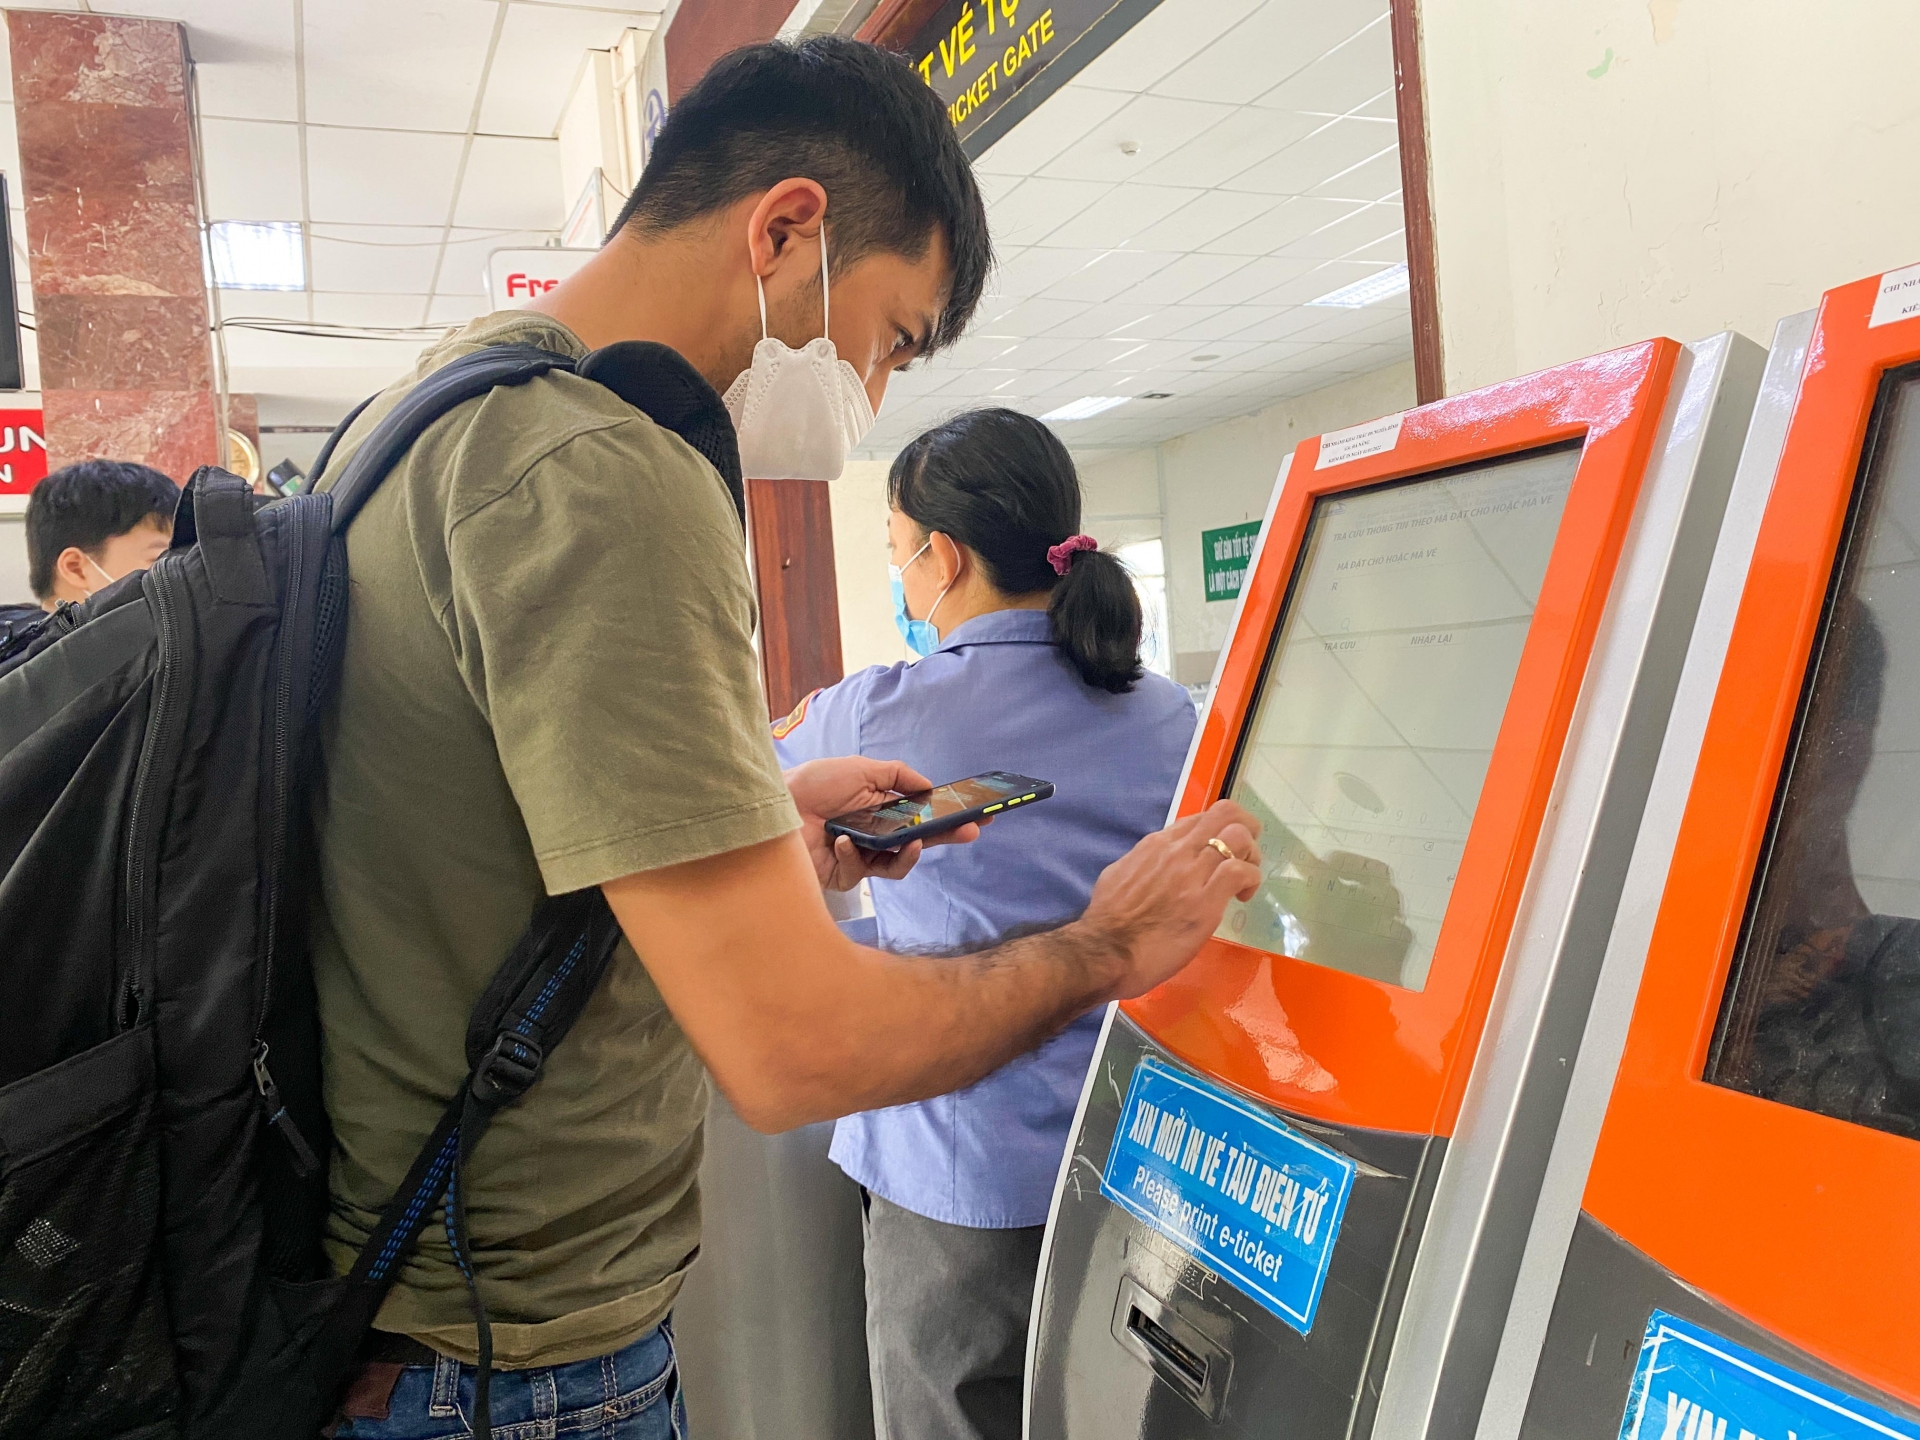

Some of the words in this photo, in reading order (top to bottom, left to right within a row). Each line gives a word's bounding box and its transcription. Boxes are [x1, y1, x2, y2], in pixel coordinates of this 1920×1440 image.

[939, 1, 976, 78] VÉ
[1003, 8, 1055, 77] GATE
[1395, 520, 1409, 530] TIN
[1411, 516, 1433, 528] THEO
[1327, 880, 1336, 892] N
[1129, 1098, 1160, 1149] XIN
[1180, 1126, 1206, 1176] IN
[1200, 1132, 1228, 1188] VÉ
[1220, 1142, 1258, 1206] TÀU
[1250, 1164, 1300, 1234] ĐIỆN
[1294, 1177, 1330, 1246] TỬ
[1132, 1164, 1180, 1212] Please
[1179, 1199, 1220, 1240] print
[1219, 1224, 1283, 1283] e-ticket
